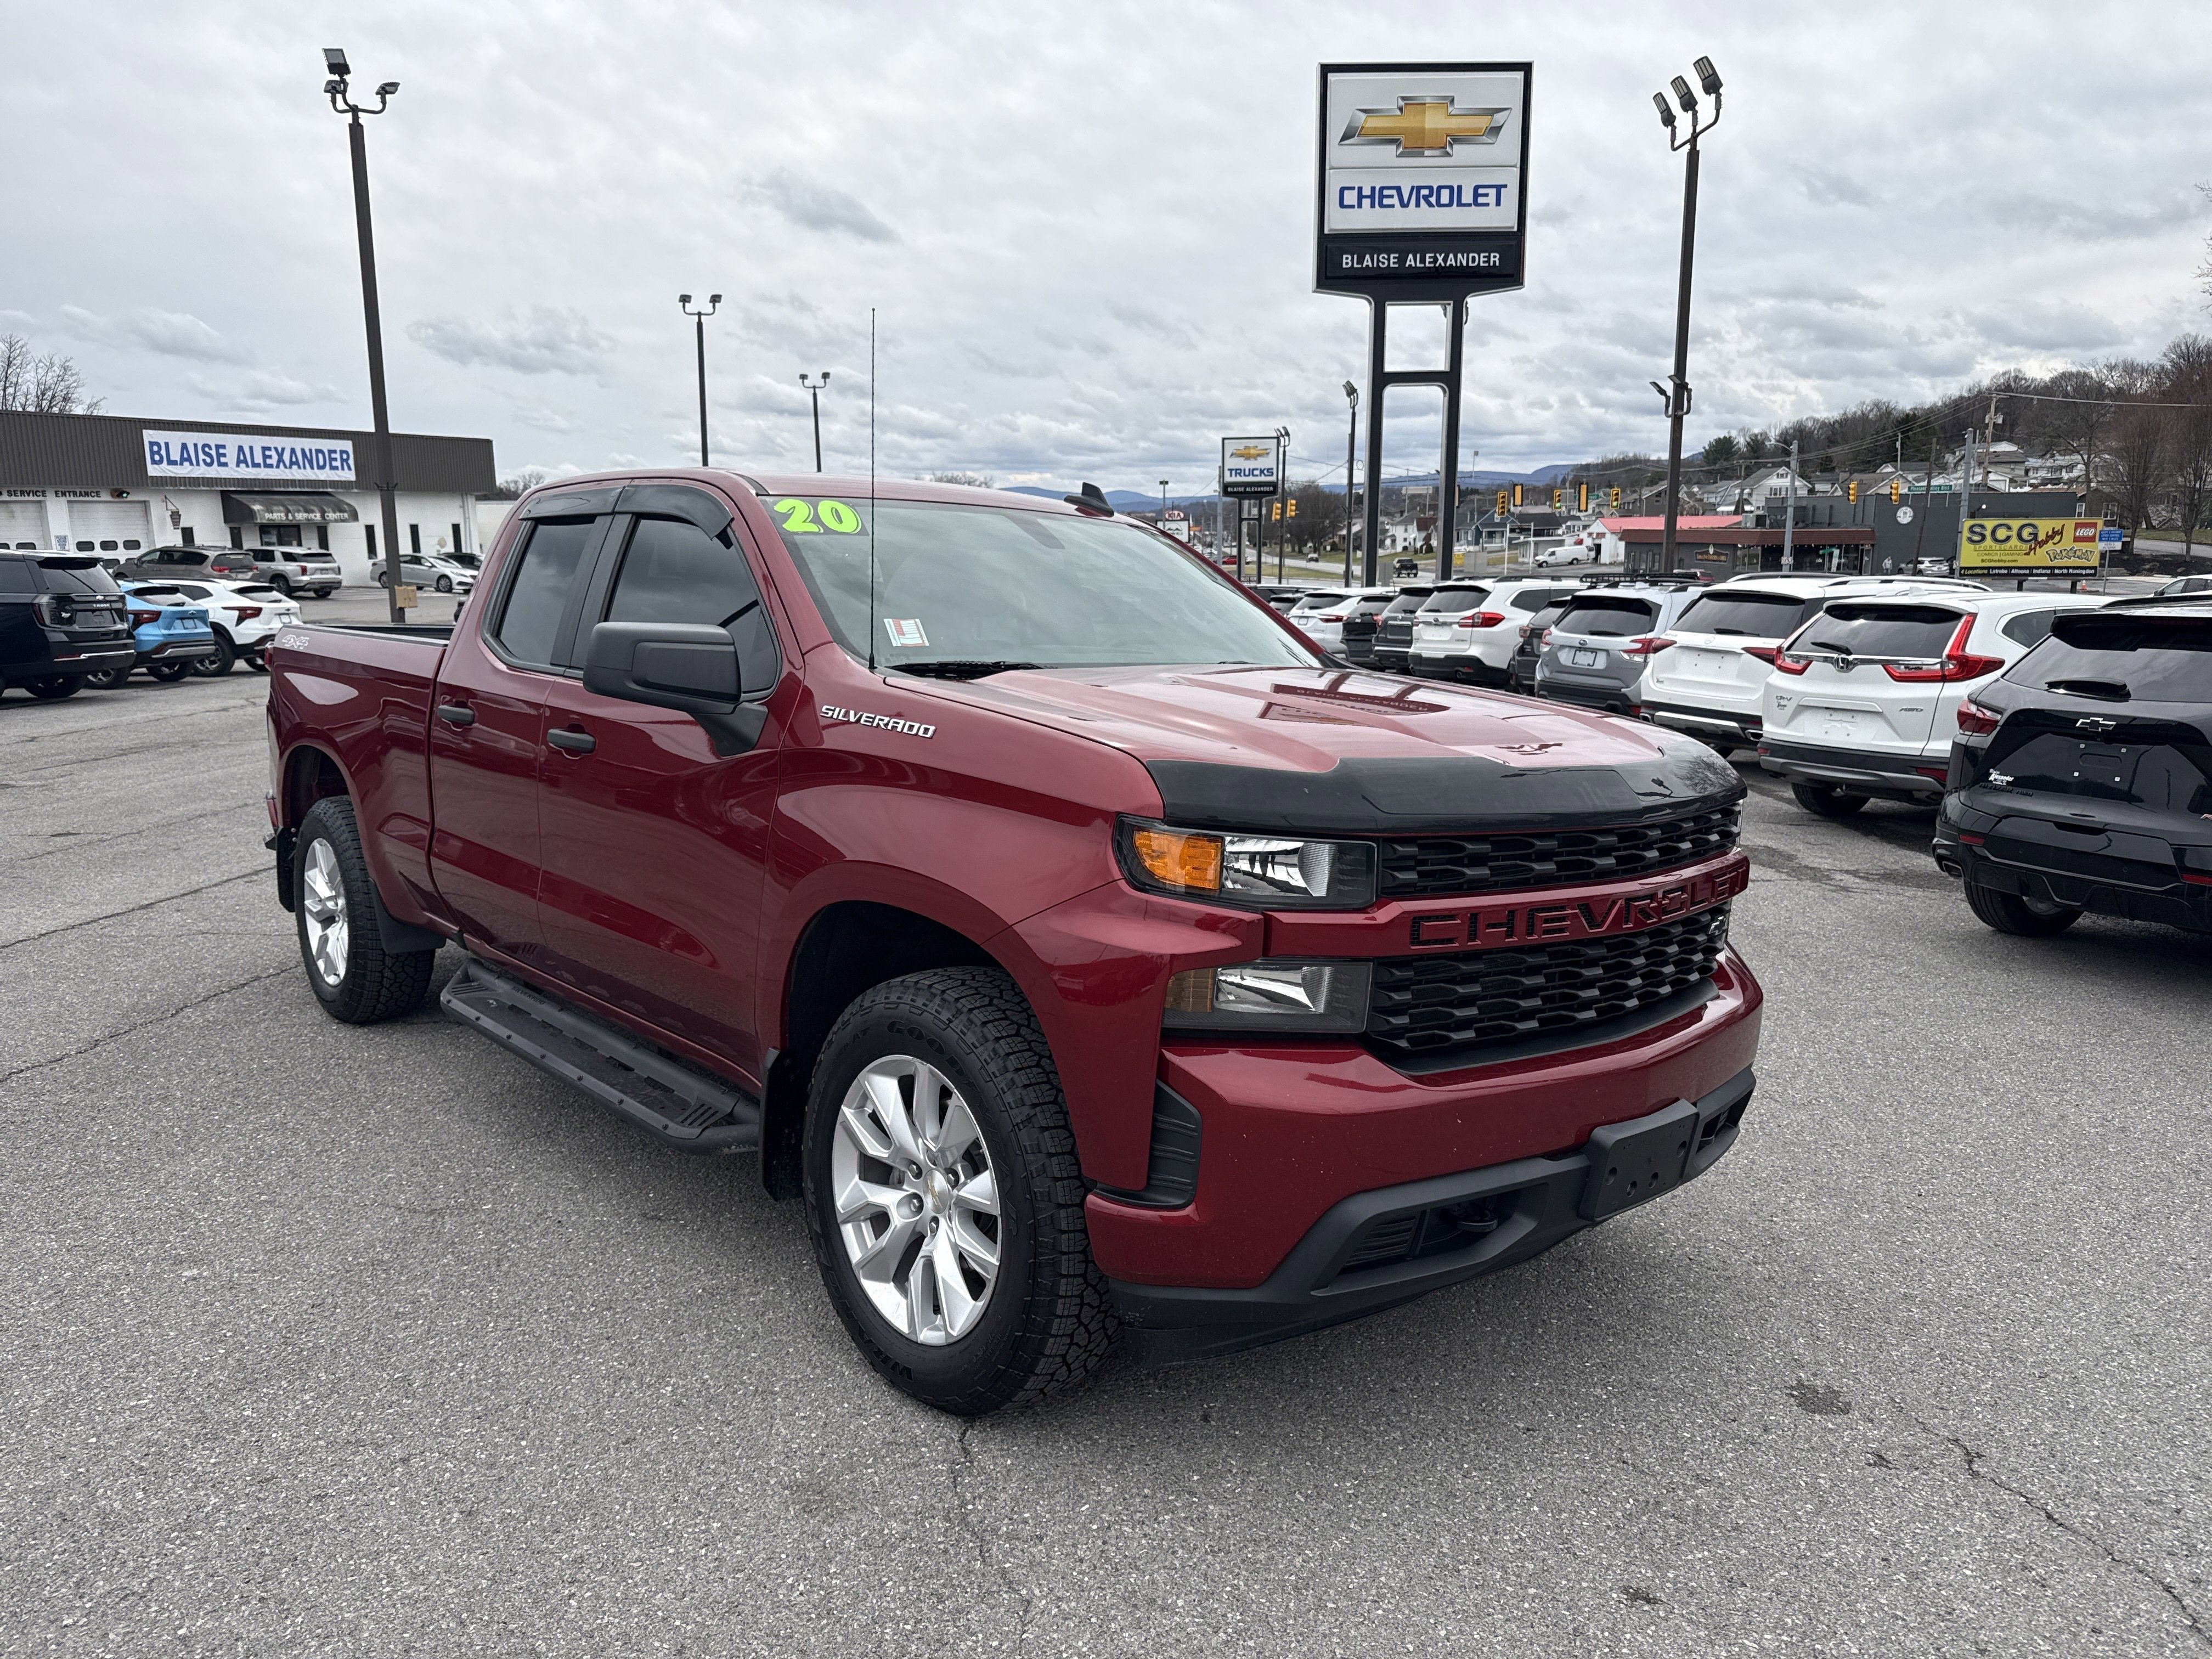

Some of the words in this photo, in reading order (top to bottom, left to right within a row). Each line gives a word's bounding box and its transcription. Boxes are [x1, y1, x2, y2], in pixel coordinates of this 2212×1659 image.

[1339, 184, 1508, 208] CHEVROLET
[1342, 254, 1399, 268] BLAISE
[1405, 253, 1500, 267] ALEXANDER
[148, 441, 228, 467] BLAISE
[236, 445, 352, 471] ALEXANDER
[1227, 468, 1274, 477] TRUCKS
[7, 489, 47, 498] SERVICE
[774, 499, 862, 534] 20
[1966, 523, 2040, 545] SCG
[2023, 523, 2066, 556] Hobby
[820, 705, 936, 739] SILVERADO
[1988, 773, 2015, 781] Alexander
[1409, 862, 1748, 950] CHEVROLET
